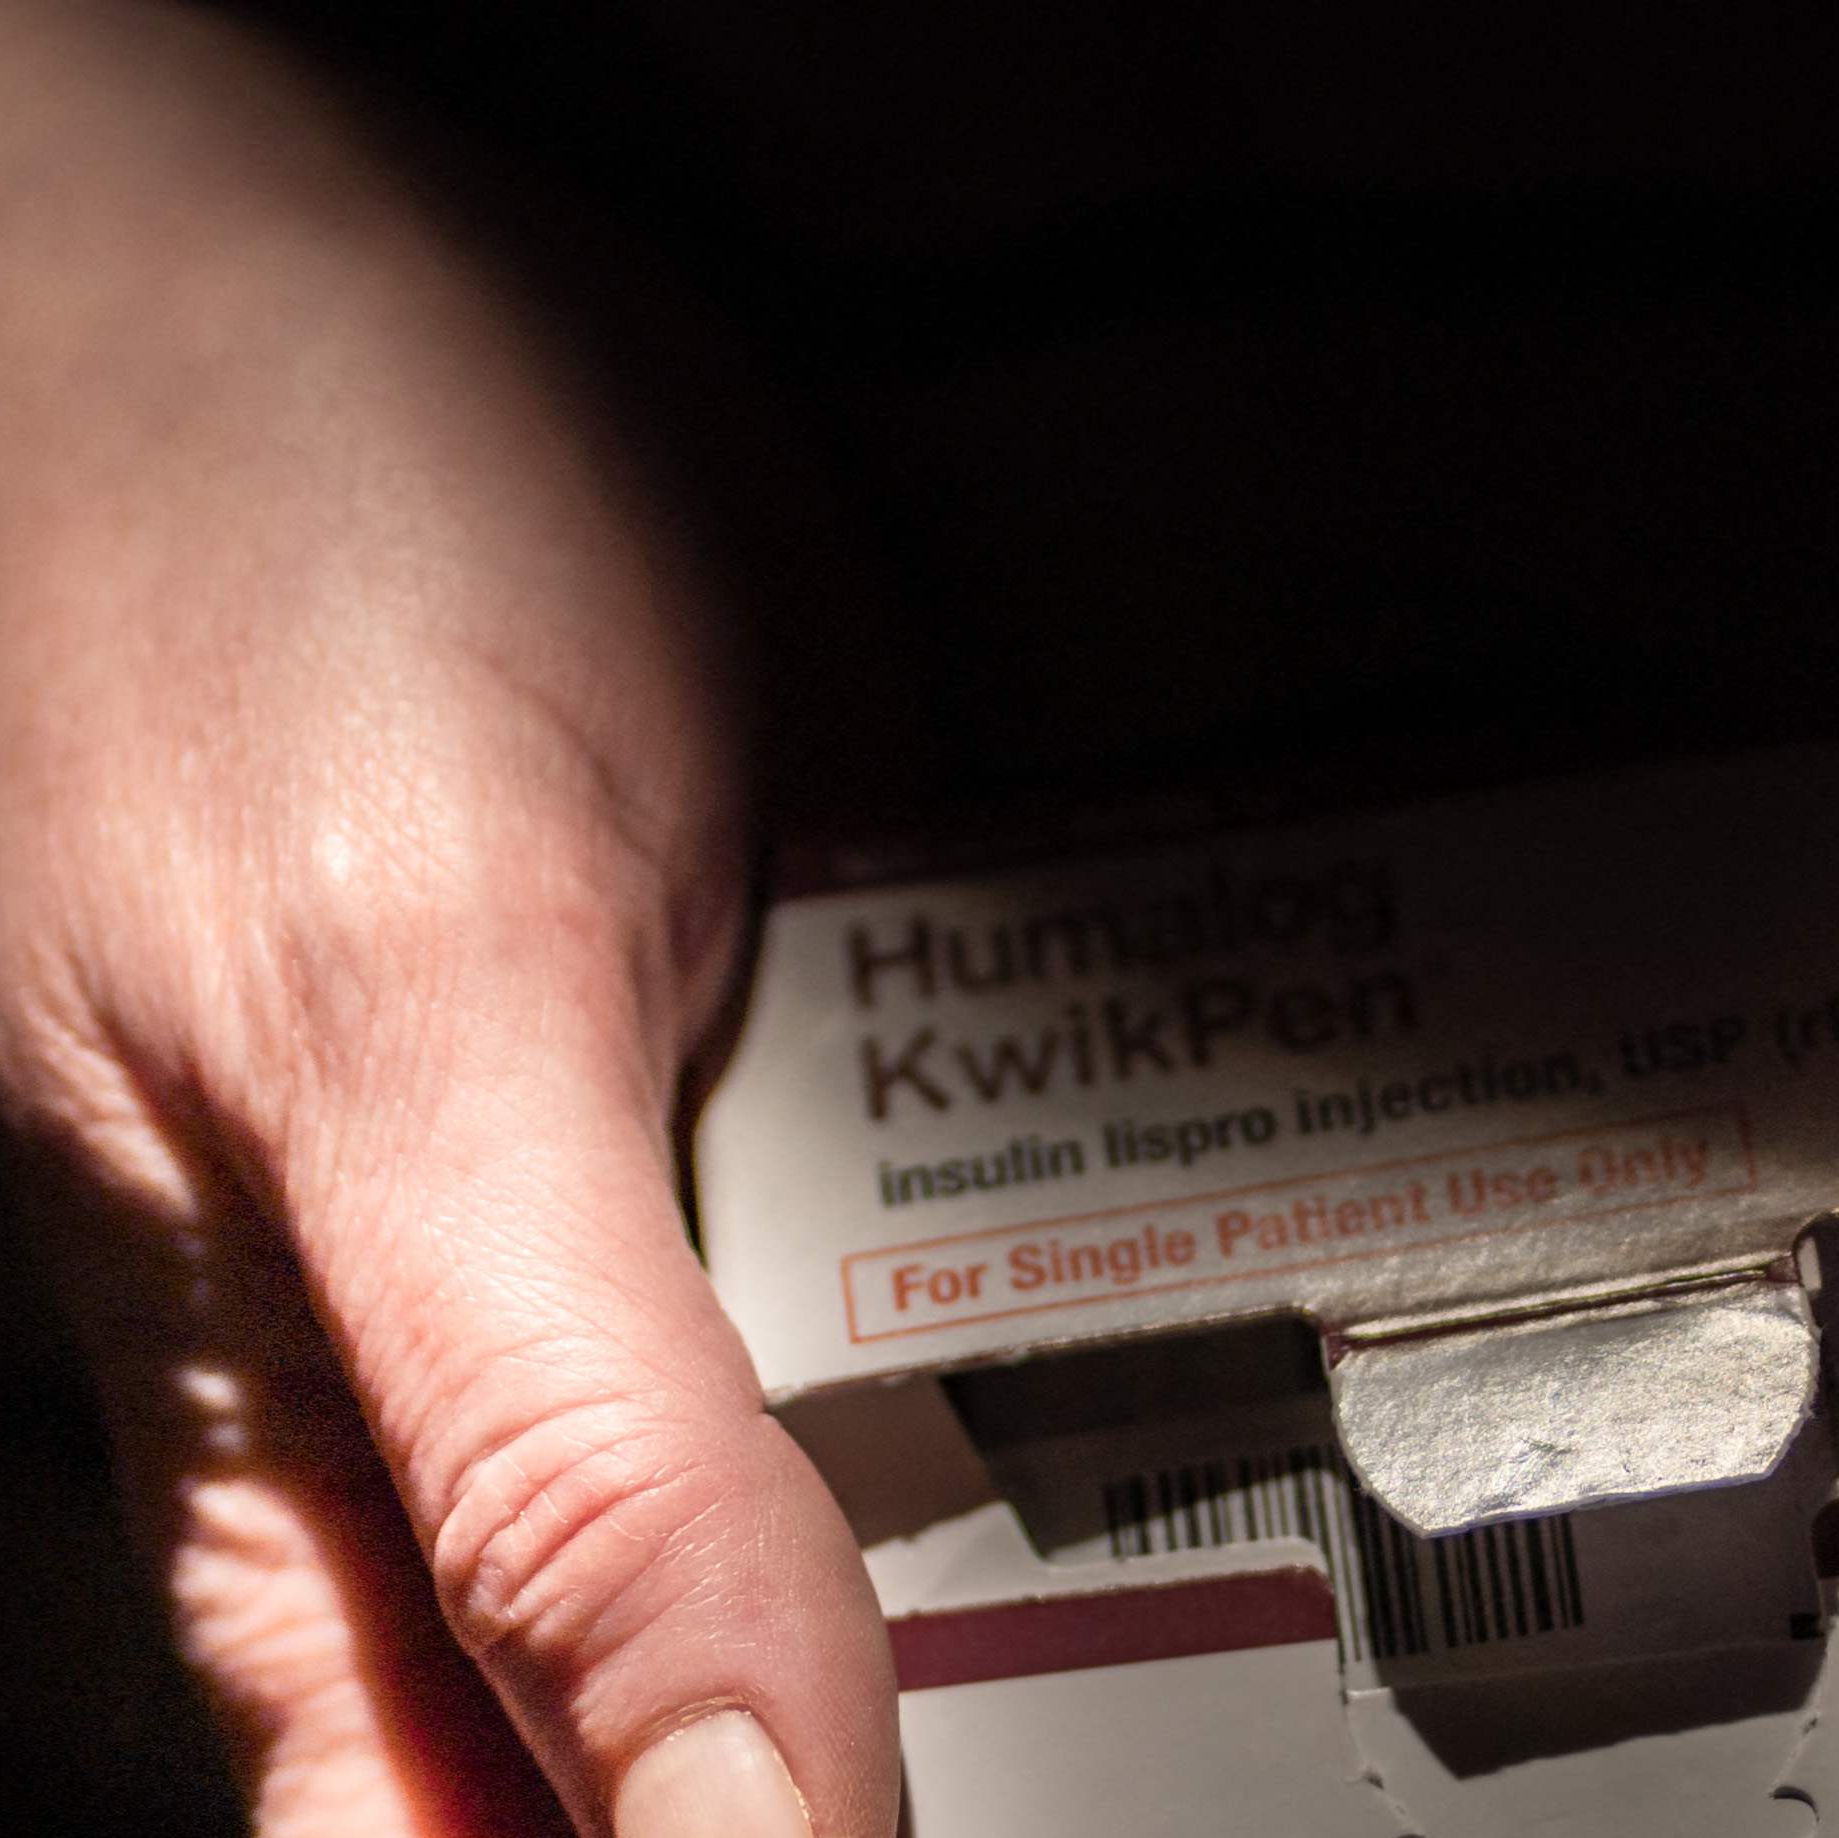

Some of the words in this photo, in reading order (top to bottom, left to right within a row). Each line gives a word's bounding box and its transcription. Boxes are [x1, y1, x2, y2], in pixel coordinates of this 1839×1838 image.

[846, 856, 1393, 1006] Humalog
[879, 1134, 1084, 1207] insulin
[1103, 1103, 1278, 1169] lispro
[1296, 1051, 1601, 1137] injection,
[1617, 1011, 1746, 1078] USP
[892, 1257, 987, 1310] For
[1009, 1222, 1195, 1291] Single
[1215, 1182, 1432, 1258] Patient
[1446, 1162, 1557, 1216] Use
[1578, 1133, 1708, 1190] Only
